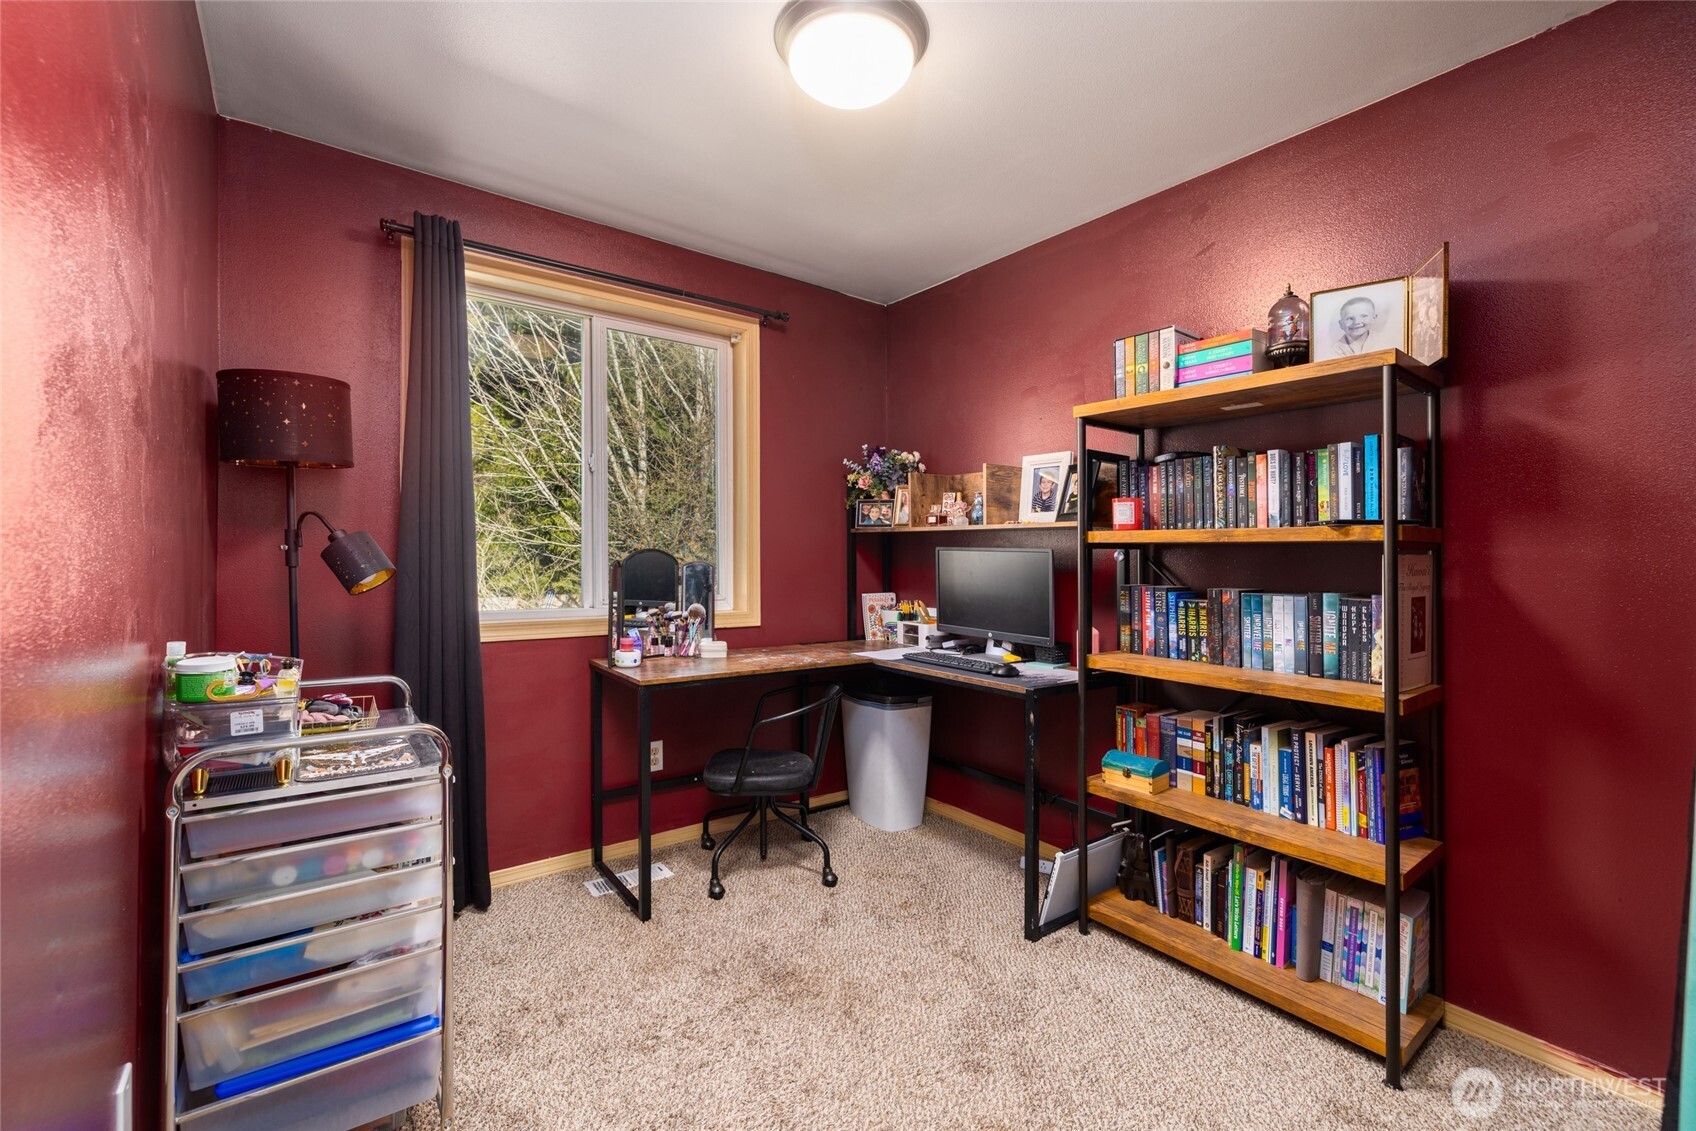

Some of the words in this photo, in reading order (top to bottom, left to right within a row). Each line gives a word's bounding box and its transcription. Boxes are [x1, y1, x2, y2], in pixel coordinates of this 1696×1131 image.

[1188, 611, 1196, 637] HARRIS
[1200, 610, 1208, 637] HARRIS
[1253, 614, 1262, 640] UNRAVEL
[1264, 617, 1272, 639] IGNITE
[1324, 610, 1336, 639] IGNITE
[1253, 641, 1262, 651] ME
[1264, 641, 1272, 652] ME
[1297, 641, 1305, 651] ME
[1324, 641, 1336, 655] ME
